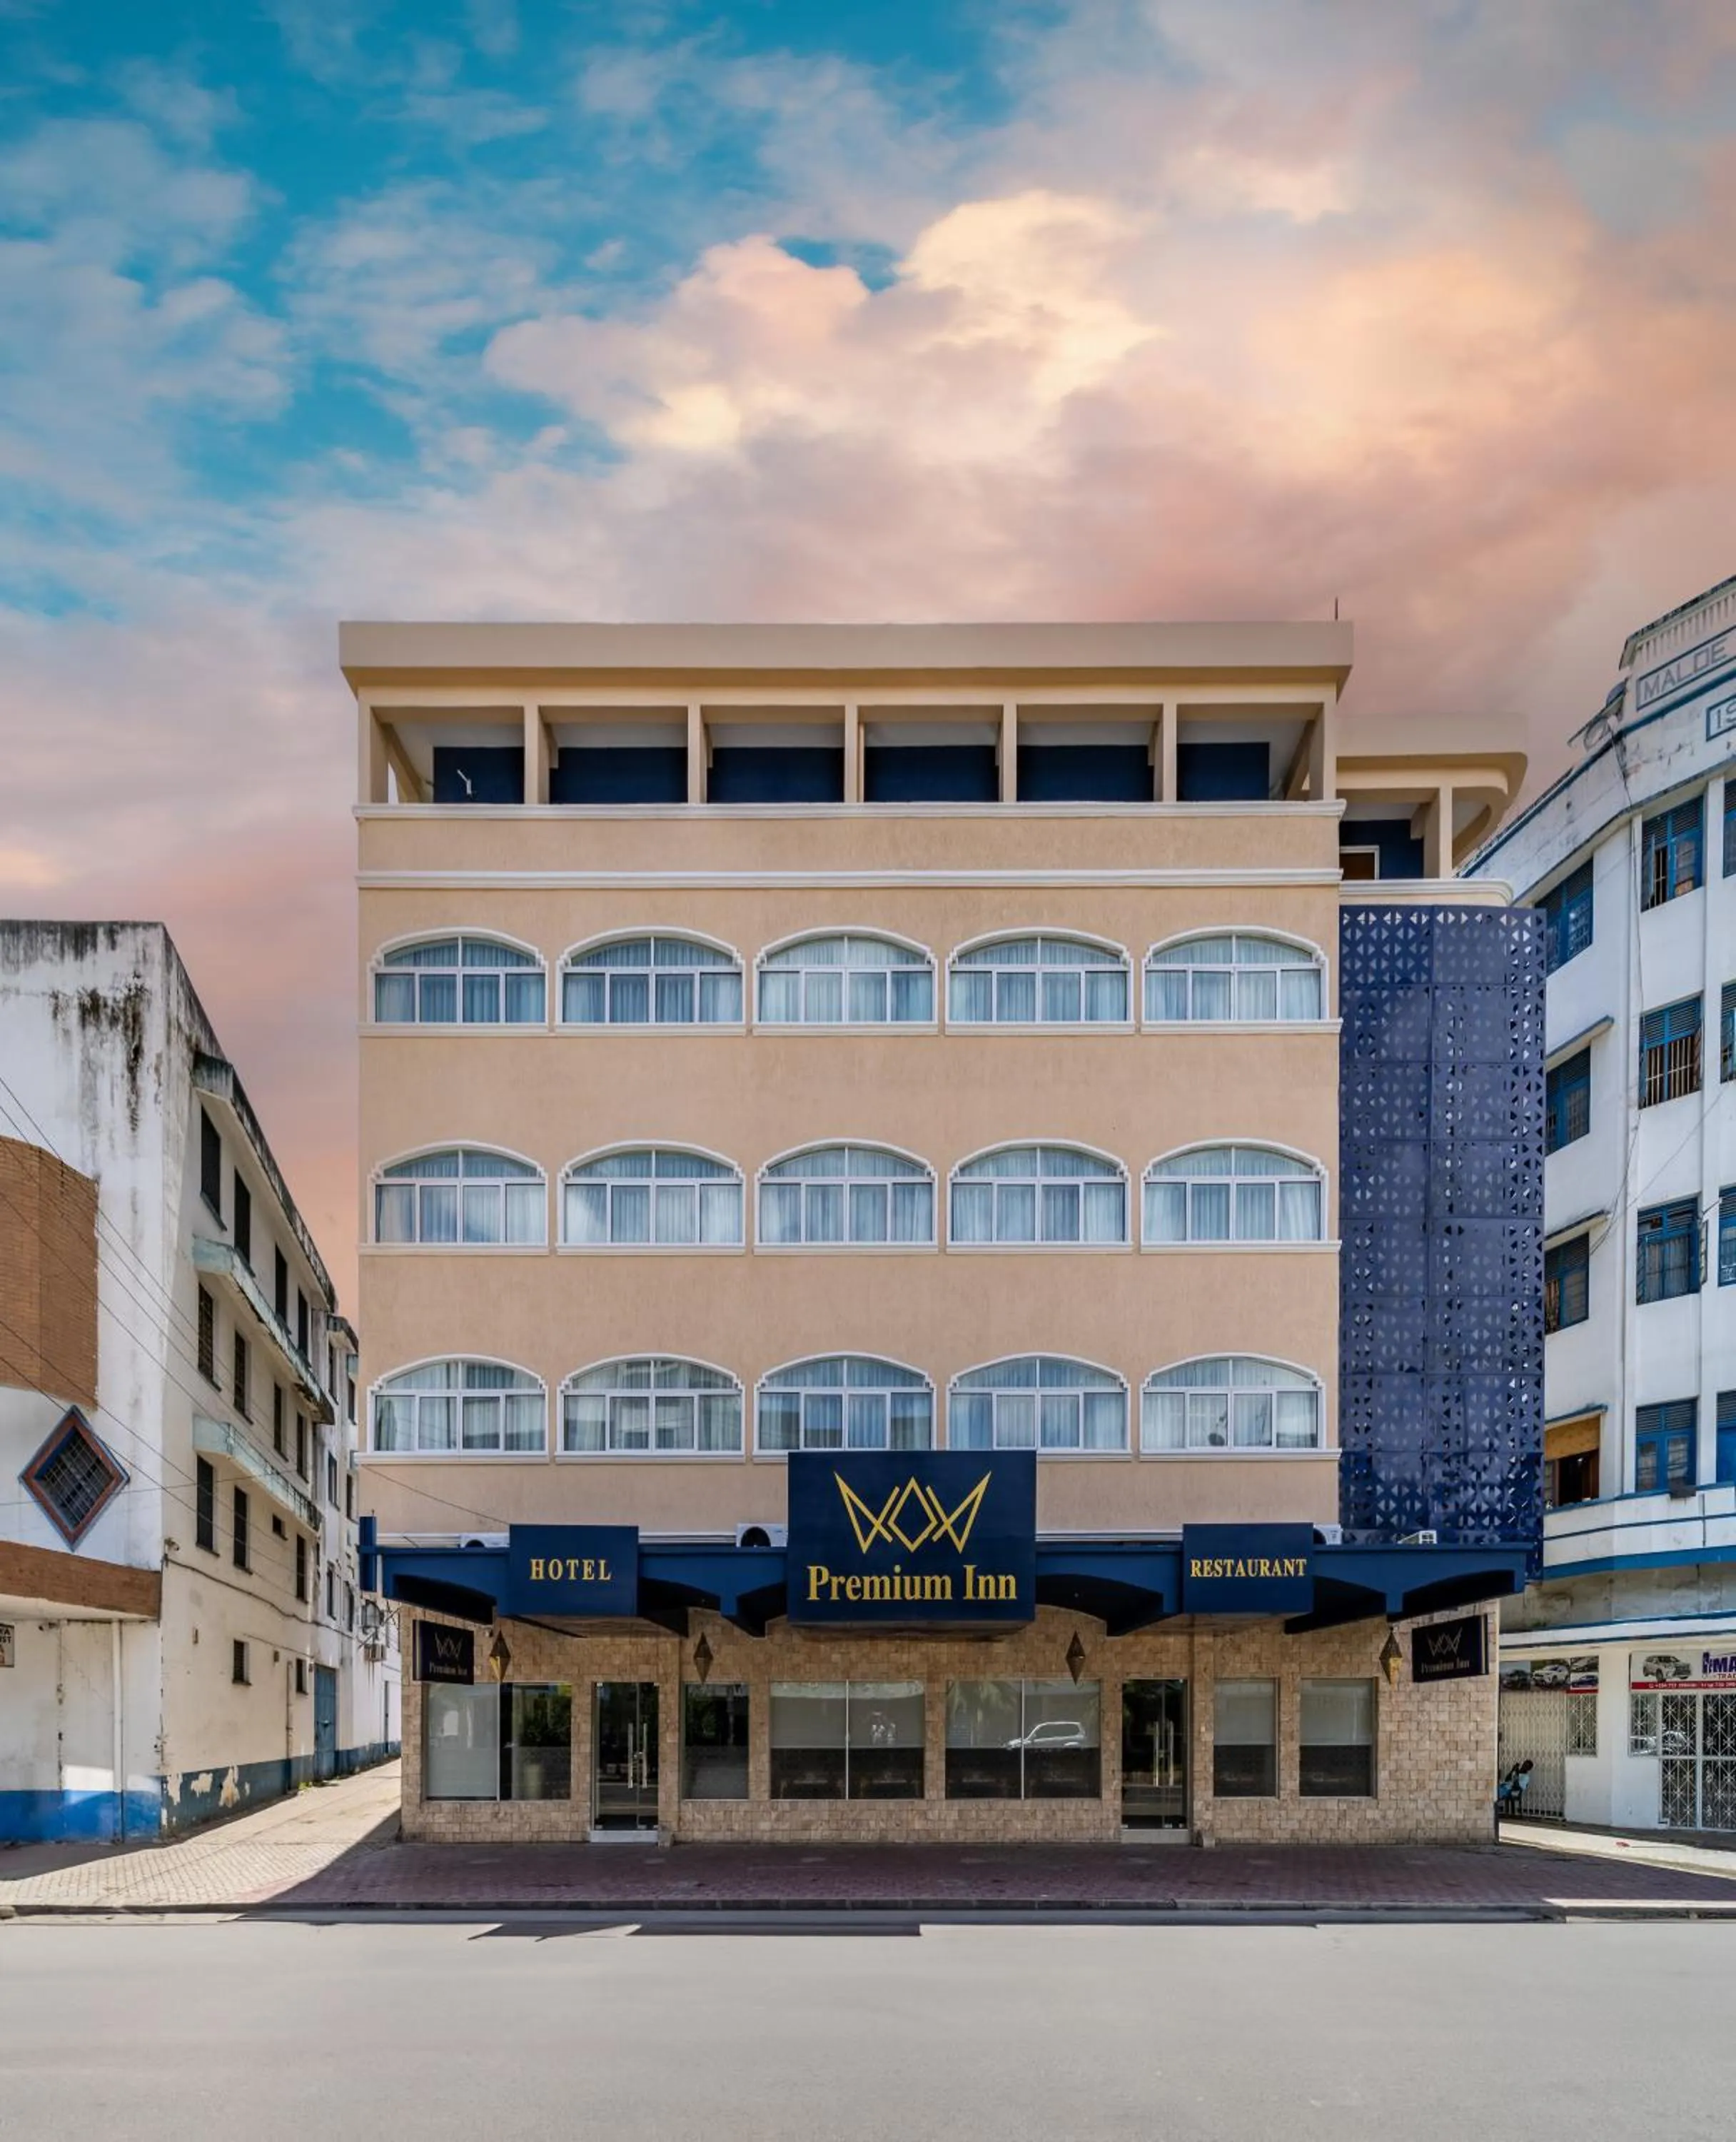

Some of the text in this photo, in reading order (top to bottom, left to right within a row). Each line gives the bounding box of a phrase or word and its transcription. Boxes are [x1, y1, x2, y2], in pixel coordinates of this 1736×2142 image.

[530, 1559, 612, 1580] HOTEL
[1190, 1559, 1307, 1577] RESTAURANT
[807, 1564, 1017, 1600] Premium Inn
